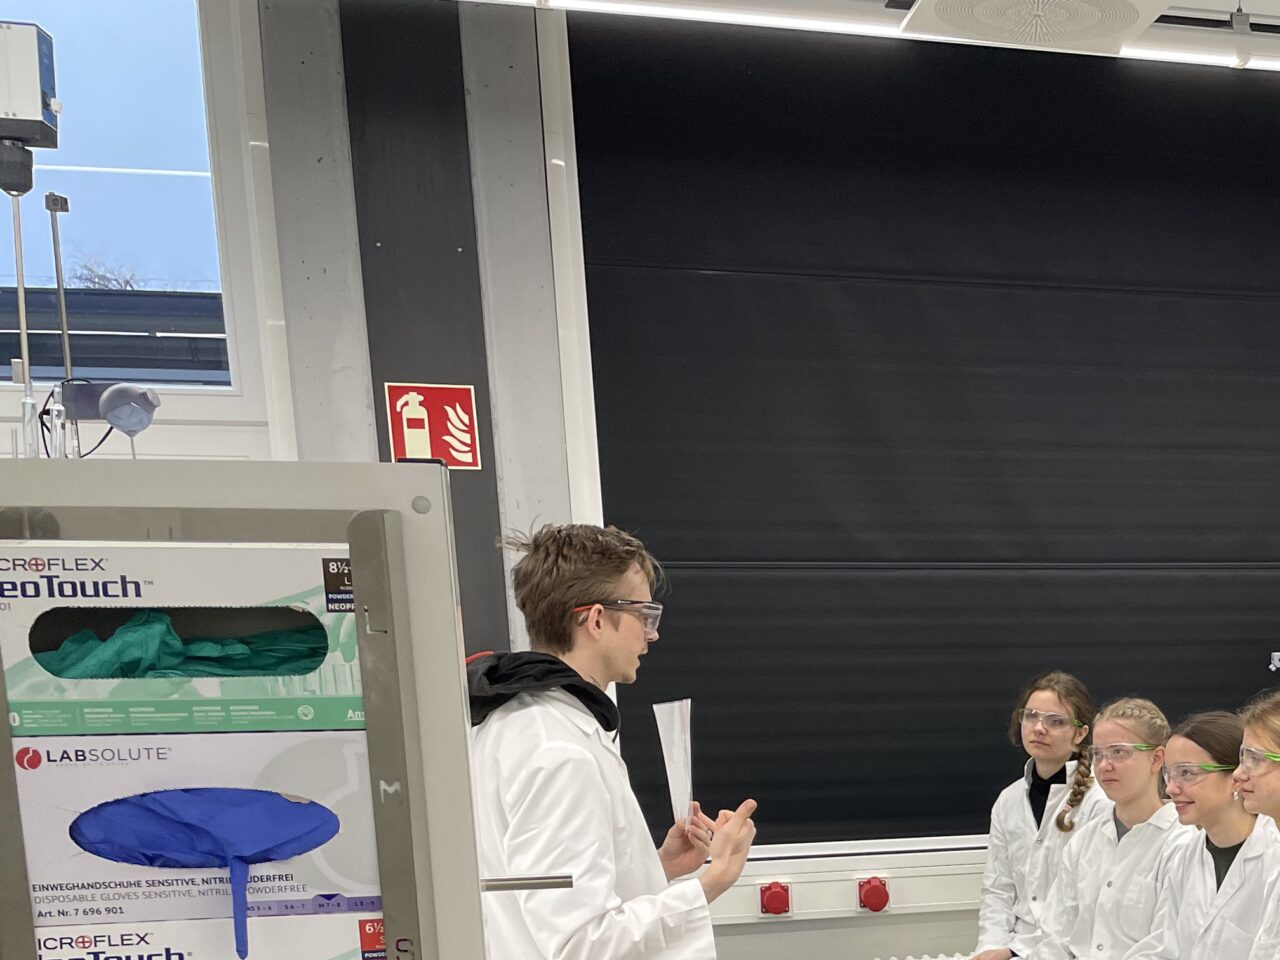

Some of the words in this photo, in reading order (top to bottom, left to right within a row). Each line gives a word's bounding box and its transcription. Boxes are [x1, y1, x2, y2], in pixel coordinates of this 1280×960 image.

[46, 748, 168, 763] LABSOLUTE
[32, 880, 143, 893] EINWEGHANDSCHUHE
[145, 877, 200, 889] SENSITIVE,
[34, 893, 97, 905] DISPOSABLE
[100, 891, 140, 902] GLOVES
[37, 909, 56, 918] Art.
[57, 909, 72, 917] Nr.
[73, 908, 79, 916] 7
[82, 907, 101, 916] 696
[105, 906, 124, 915] 901
